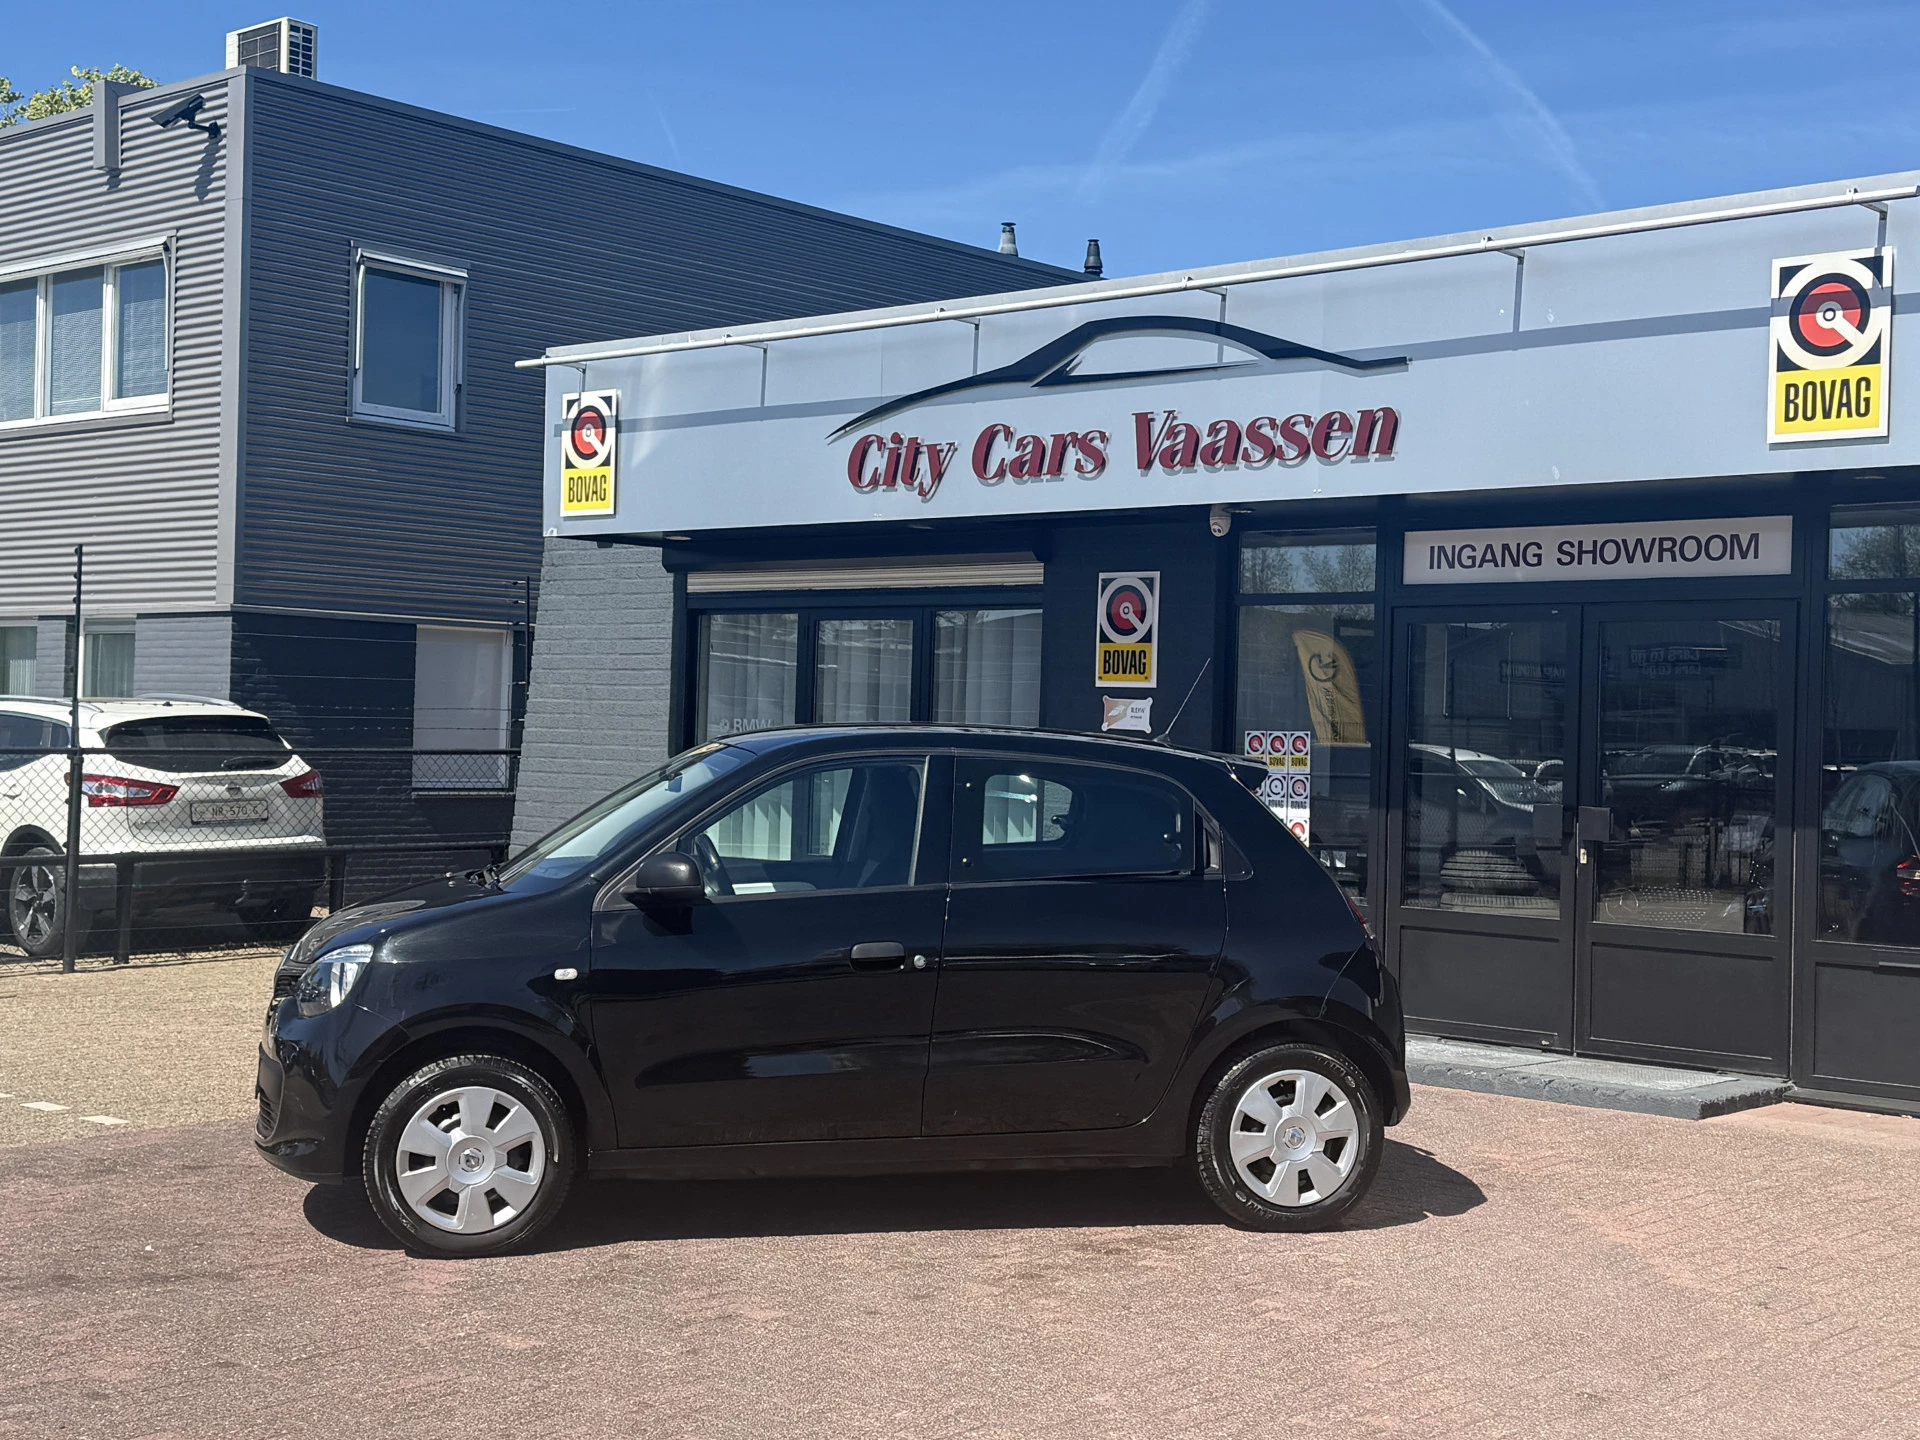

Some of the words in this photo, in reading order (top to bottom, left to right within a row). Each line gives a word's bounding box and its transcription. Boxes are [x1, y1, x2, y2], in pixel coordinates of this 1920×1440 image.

[1784, 377, 1871, 423] BOVAG
[848, 431, 957, 501] City
[973, 421, 1108, 485] Cars
[1133, 404, 1400, 478] Vaassen
[568, 474, 607, 503] BOVAG
[1429, 541, 1543, 570] INGANG
[1556, 533, 1760, 566] SHOWROOM
[1103, 650, 1147, 675] BOVAG
[733, 718, 771, 733] BMW
